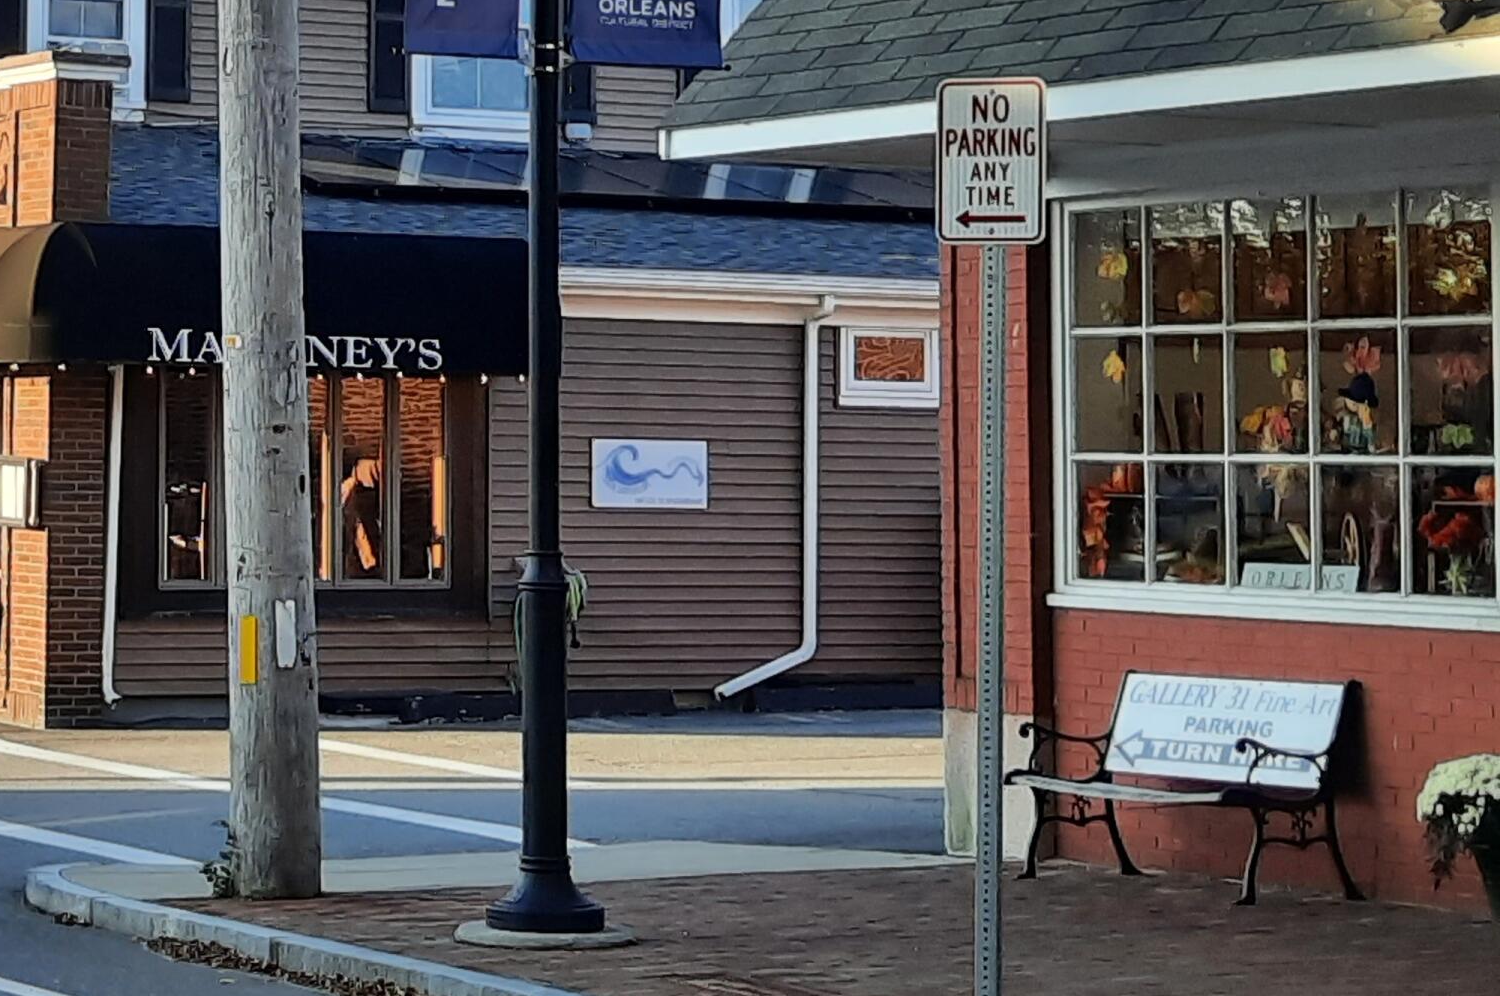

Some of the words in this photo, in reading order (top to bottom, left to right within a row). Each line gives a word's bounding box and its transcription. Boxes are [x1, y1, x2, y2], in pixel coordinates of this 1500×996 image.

[972, 94, 1010, 124] NO
[945, 127, 1036, 157] PARKING
[970, 162, 1011, 182] ANY
[965, 186, 1016, 207] TIME
[147, 327, 443, 370] MANEY'S
[1251, 570, 1346, 590] ORLENS
[1129, 680, 1225, 708] GALLERY
[1224, 685, 1252, 710] 31
[1253, 690, 1297, 715] Fine
[1299, 691, 1339, 716] Art
[1183, 715, 1273, 739] PARKING
[1150, 740, 1224, 763] TURN
